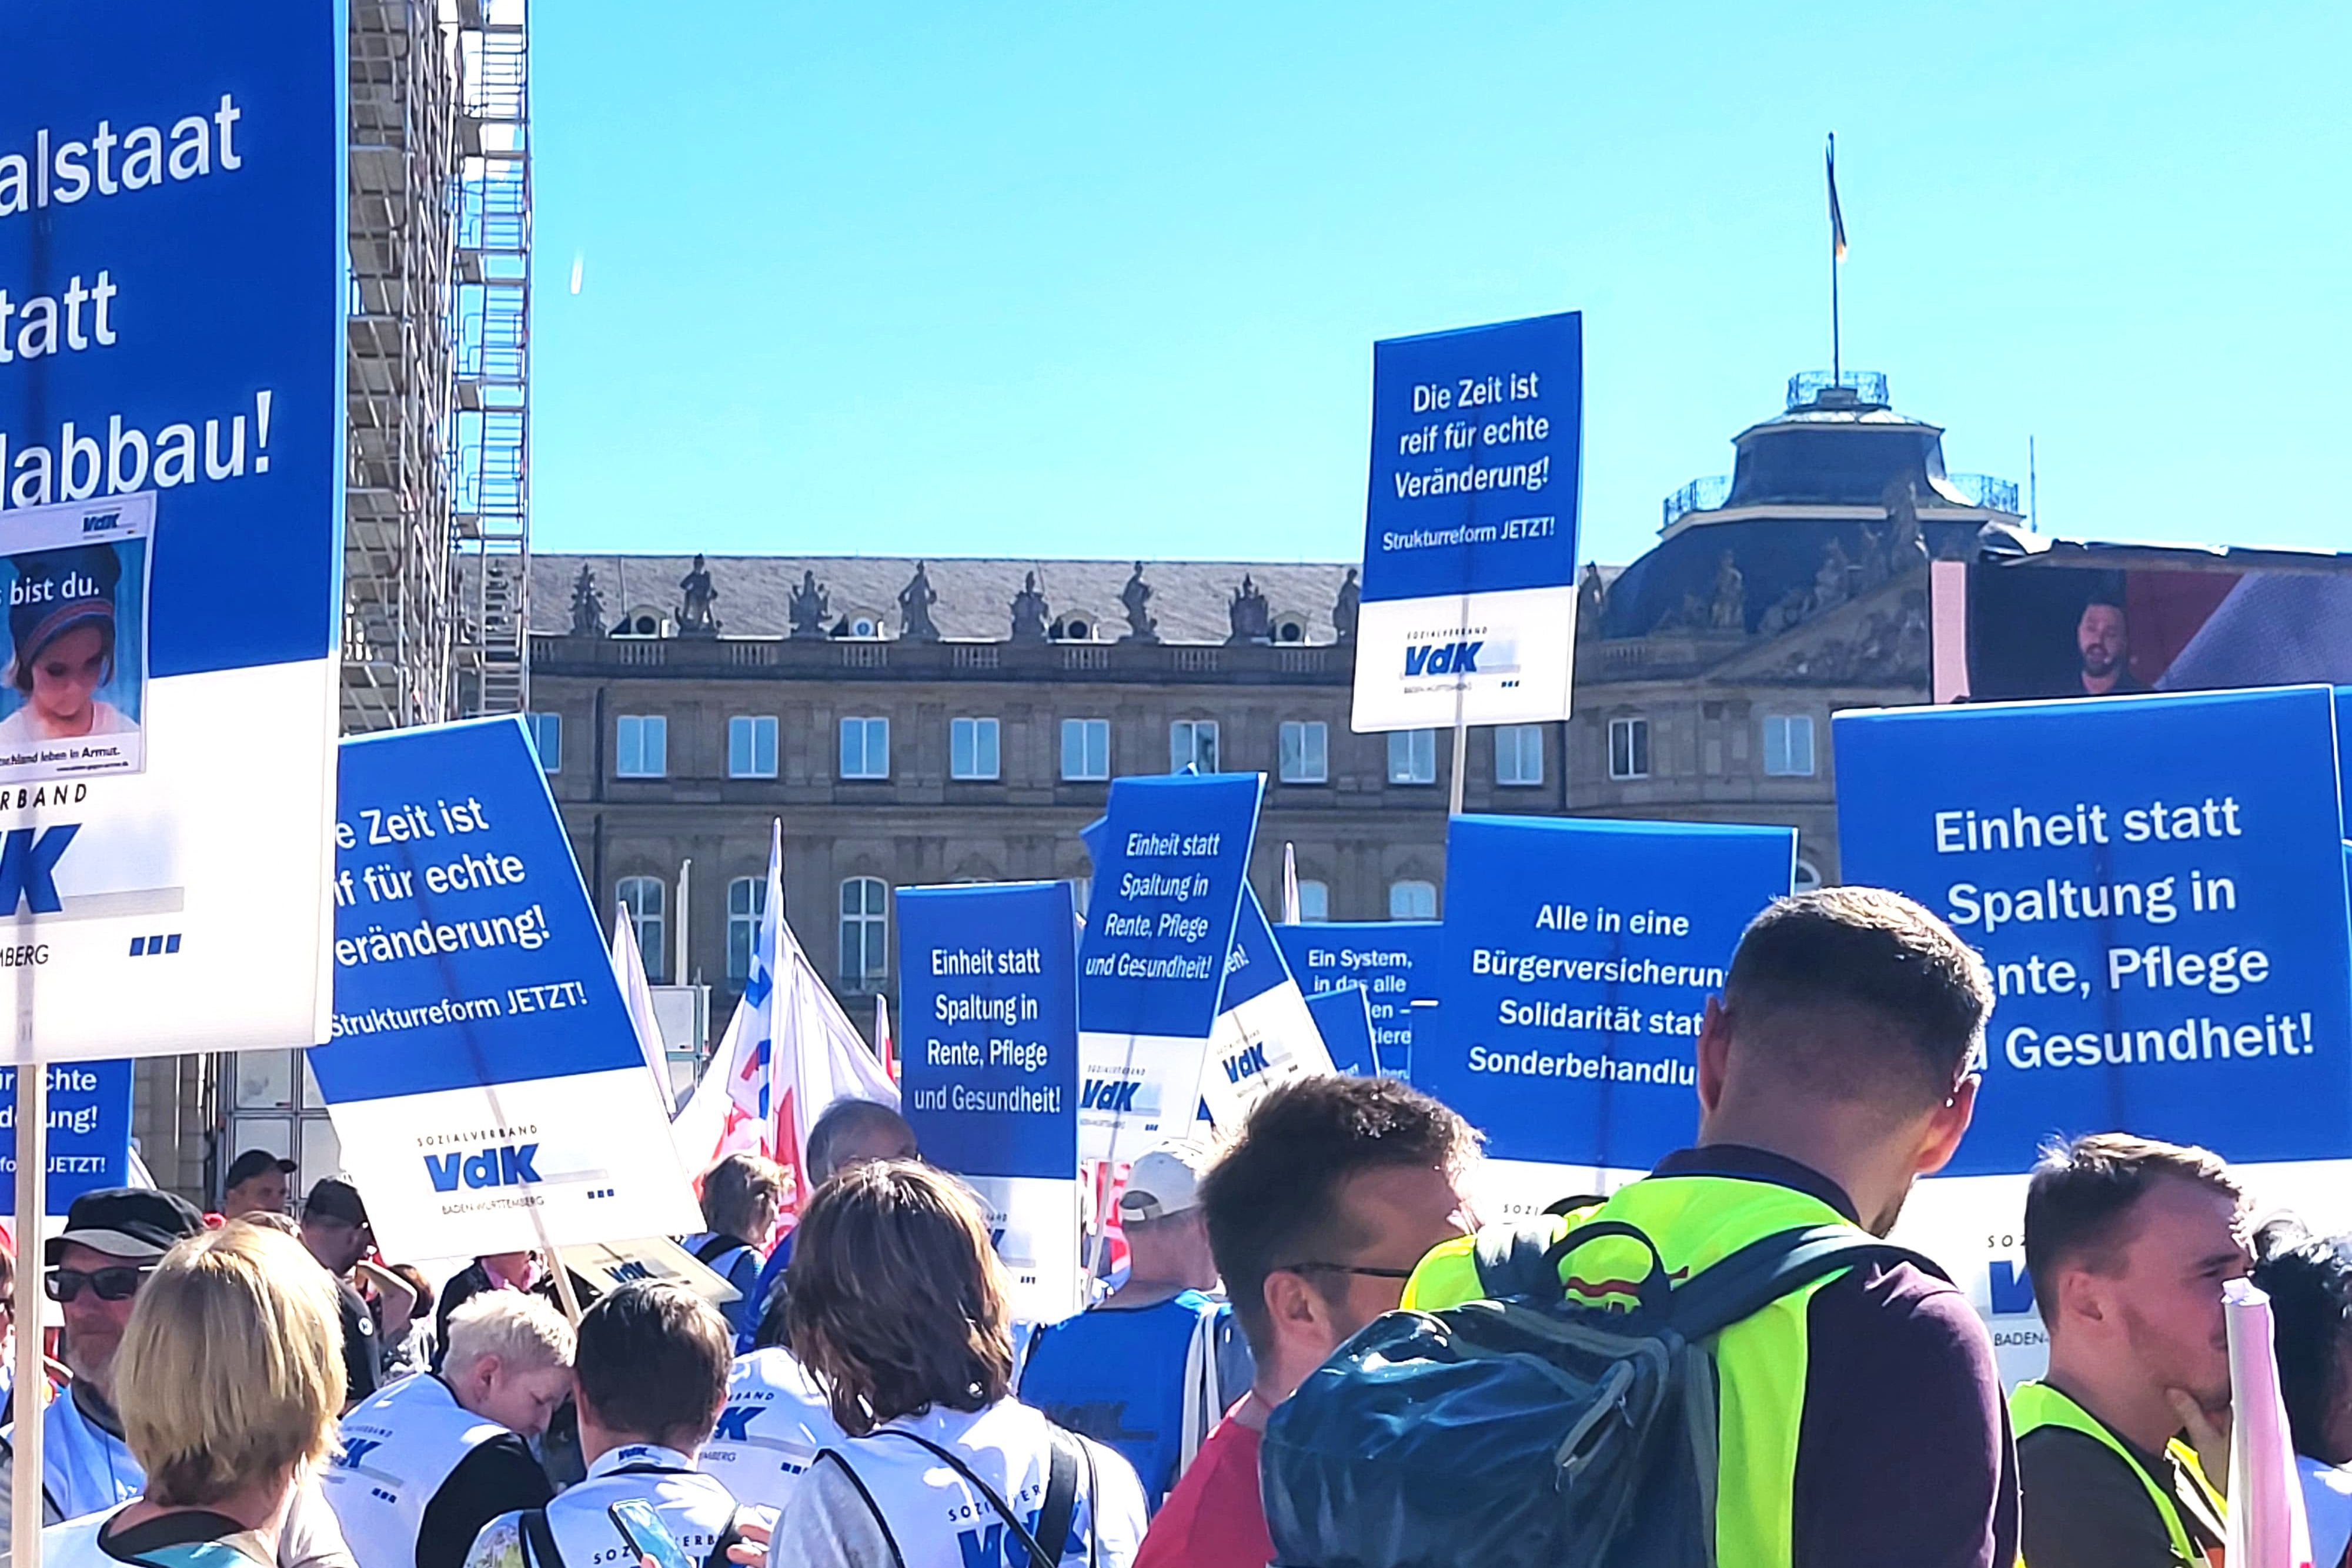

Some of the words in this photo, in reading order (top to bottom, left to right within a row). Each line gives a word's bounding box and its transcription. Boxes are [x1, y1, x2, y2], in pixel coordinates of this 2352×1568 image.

[1414, 384, 1451, 413] Die
[1458, 376, 1502, 407] Zeit
[1510, 372, 1539, 401] ist
[1399, 424, 1438, 455] reif
[1444, 421, 1476, 450] für
[1483, 415, 1549, 445] echte
[1395, 456, 1549, 499] Veränderung!
[1382, 525, 1496, 551] Strukturreform
[1501, 516, 1555, 540] JETZT!
[10, 577, 54, 605] bist
[62, 571, 99, 598] du.
[1405, 641, 1484, 676] VdK
[360, 804, 435, 845] Zeit
[437, 797, 490, 835] ist
[1935, 803, 2109, 853] Einheit
[2123, 797, 2241, 842] statt
[1126, 833, 1180, 856] Einheit
[1182, 833, 1220, 855] statt
[363, 864, 413, 902] für
[425, 852, 526, 894] echte
[1120, 872, 1191, 902] Spaltung
[1193, 873, 1208, 897] in
[1947, 875, 2177, 932] Spaltung
[2191, 870, 2236, 911] in
[1104, 914, 1152, 938] Rente,
[1157, 913, 1208, 942] Pflege
[1535, 905, 1588, 931] Alle
[1596, 908, 1621, 932] in
[1629, 910, 1689, 937] eine
[931, 948, 994, 975] Einheit
[998, 948, 1041, 974] statt
[1086, 953, 1115, 975] und
[1118, 952, 1212, 979] Gesundheit!
[1308, 950, 1335, 967] Ein
[1340, 949, 1412, 970] System,
[1473, 950, 1729, 988] Bürgerversicherun
[2109, 946, 2270, 994] Pflege
[1314, 975, 1329, 992] in
[1374, 975, 1406, 992] alle
[332, 998, 501, 1037] Strukturreform
[507, 980, 588, 1014] JETZT!
[935, 993, 1017, 1027] Spaltung
[1021, 993, 1038, 1020] in
[1498, 999, 1642, 1032] Solidarität
[927, 1039, 984, 1069] Rente,
[990, 1039, 1048, 1072] Pflege
[2004, 1012, 2314, 1070] Gesundheit!
[1222, 1041, 1270, 1084] VdK
[915, 1085, 947, 1111] und
[953, 1084, 1060, 1113] Gesundheit!
[1081, 1079, 1141, 1111] VdK
[47, 1156, 106, 1173] JETZT!
[423, 1143, 543, 1192] VdK
